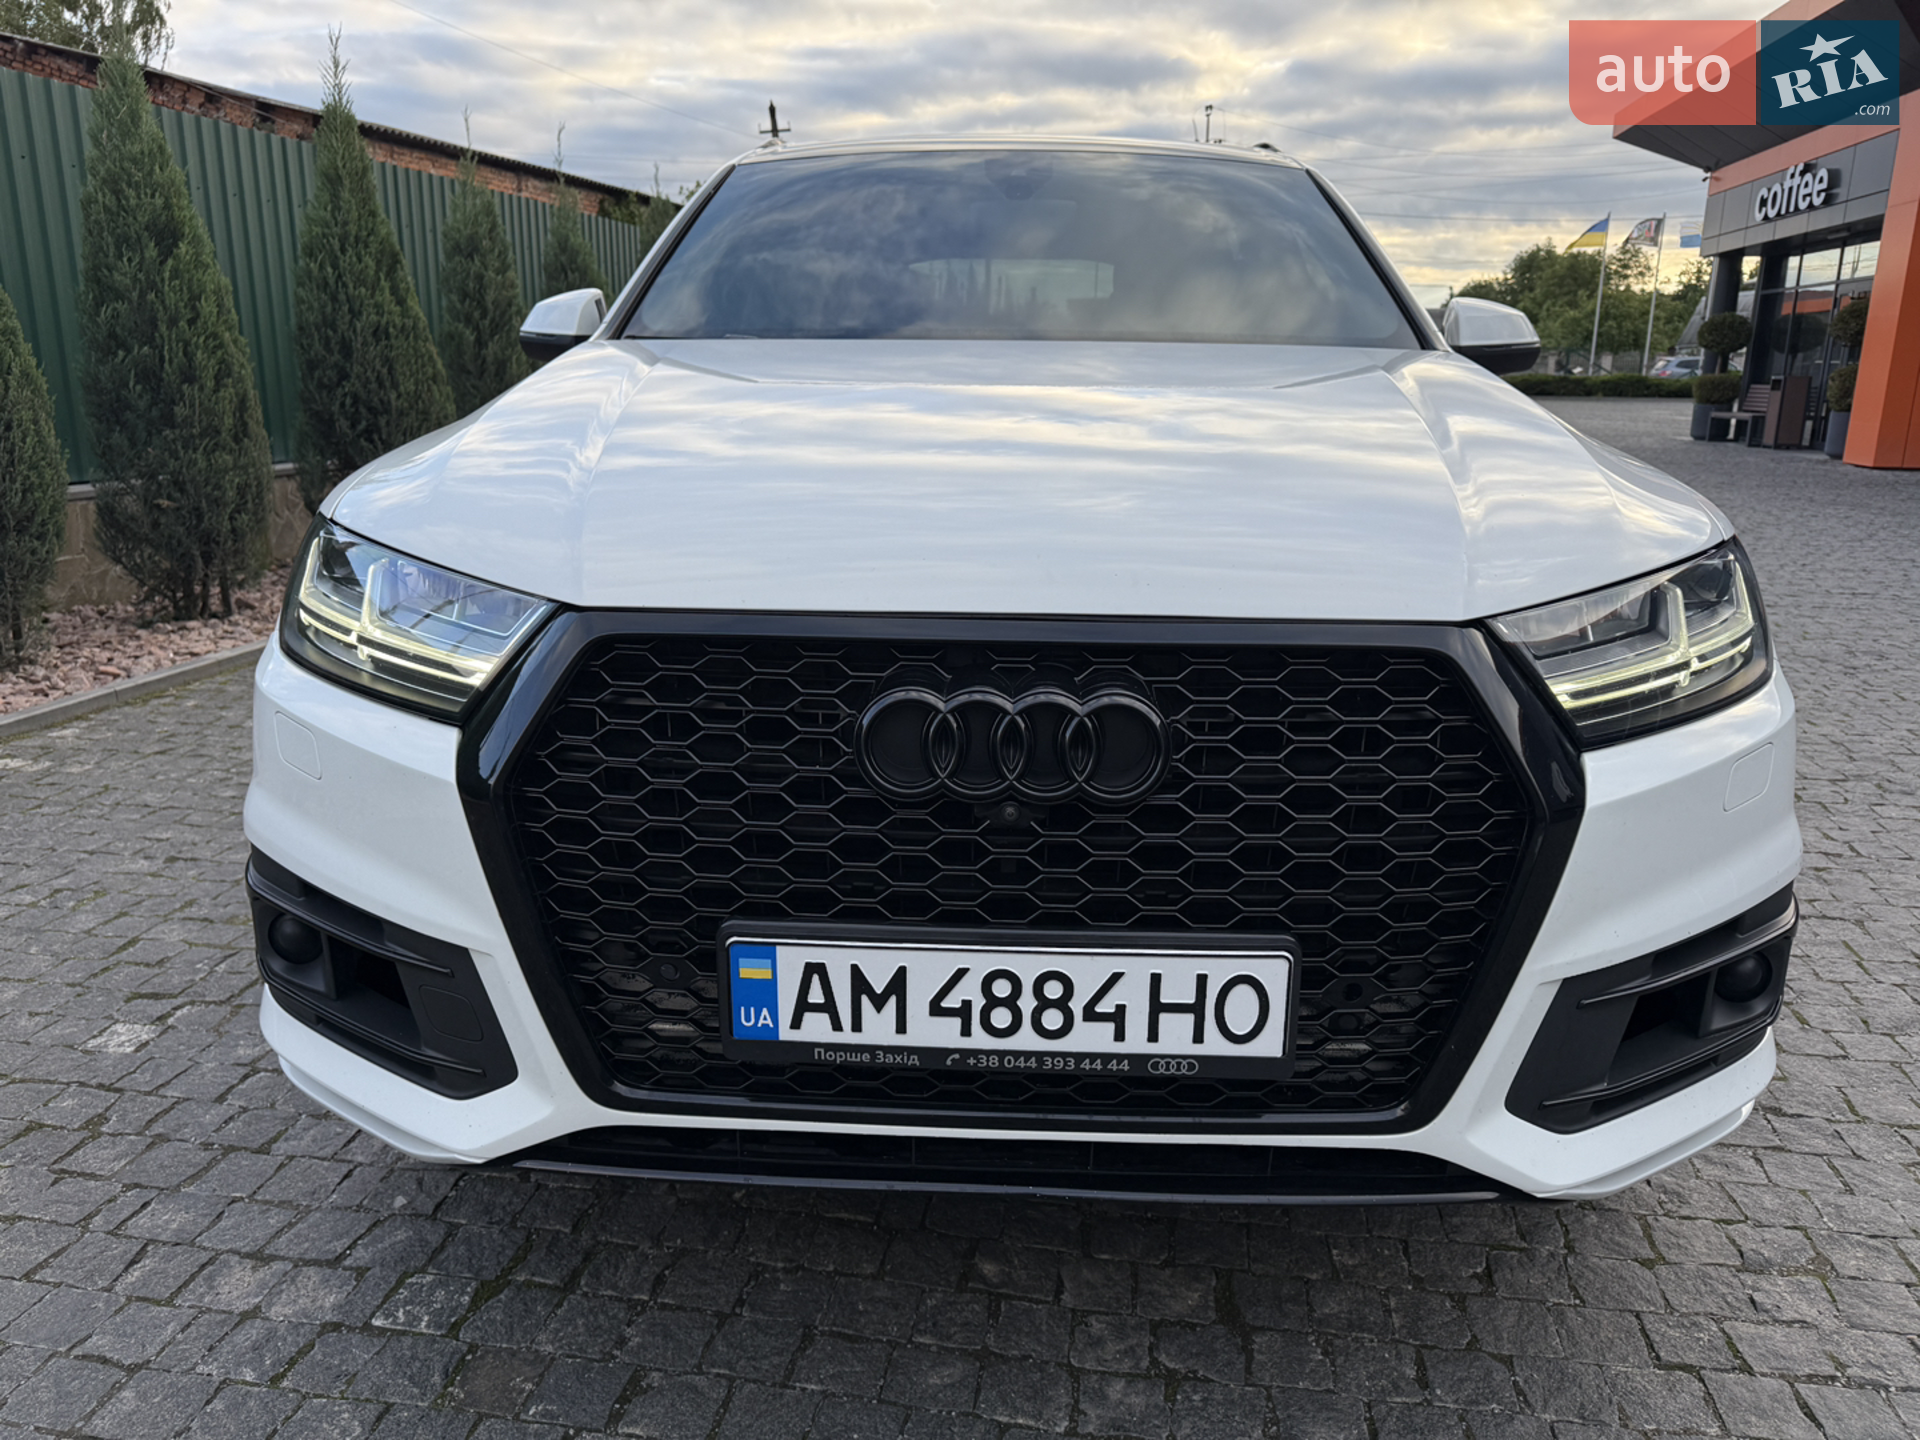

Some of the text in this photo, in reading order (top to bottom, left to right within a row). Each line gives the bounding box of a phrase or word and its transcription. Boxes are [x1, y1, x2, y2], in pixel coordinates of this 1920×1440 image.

[1754, 162, 1829, 222] coffee
[789, 960, 1271, 1045] AM 4884 HO
[739, 1006, 774, 1029] UA
[814, 1048, 920, 1066] Порше Захід
[966, 1054, 1130, 1072] +38 044 393 44 44
